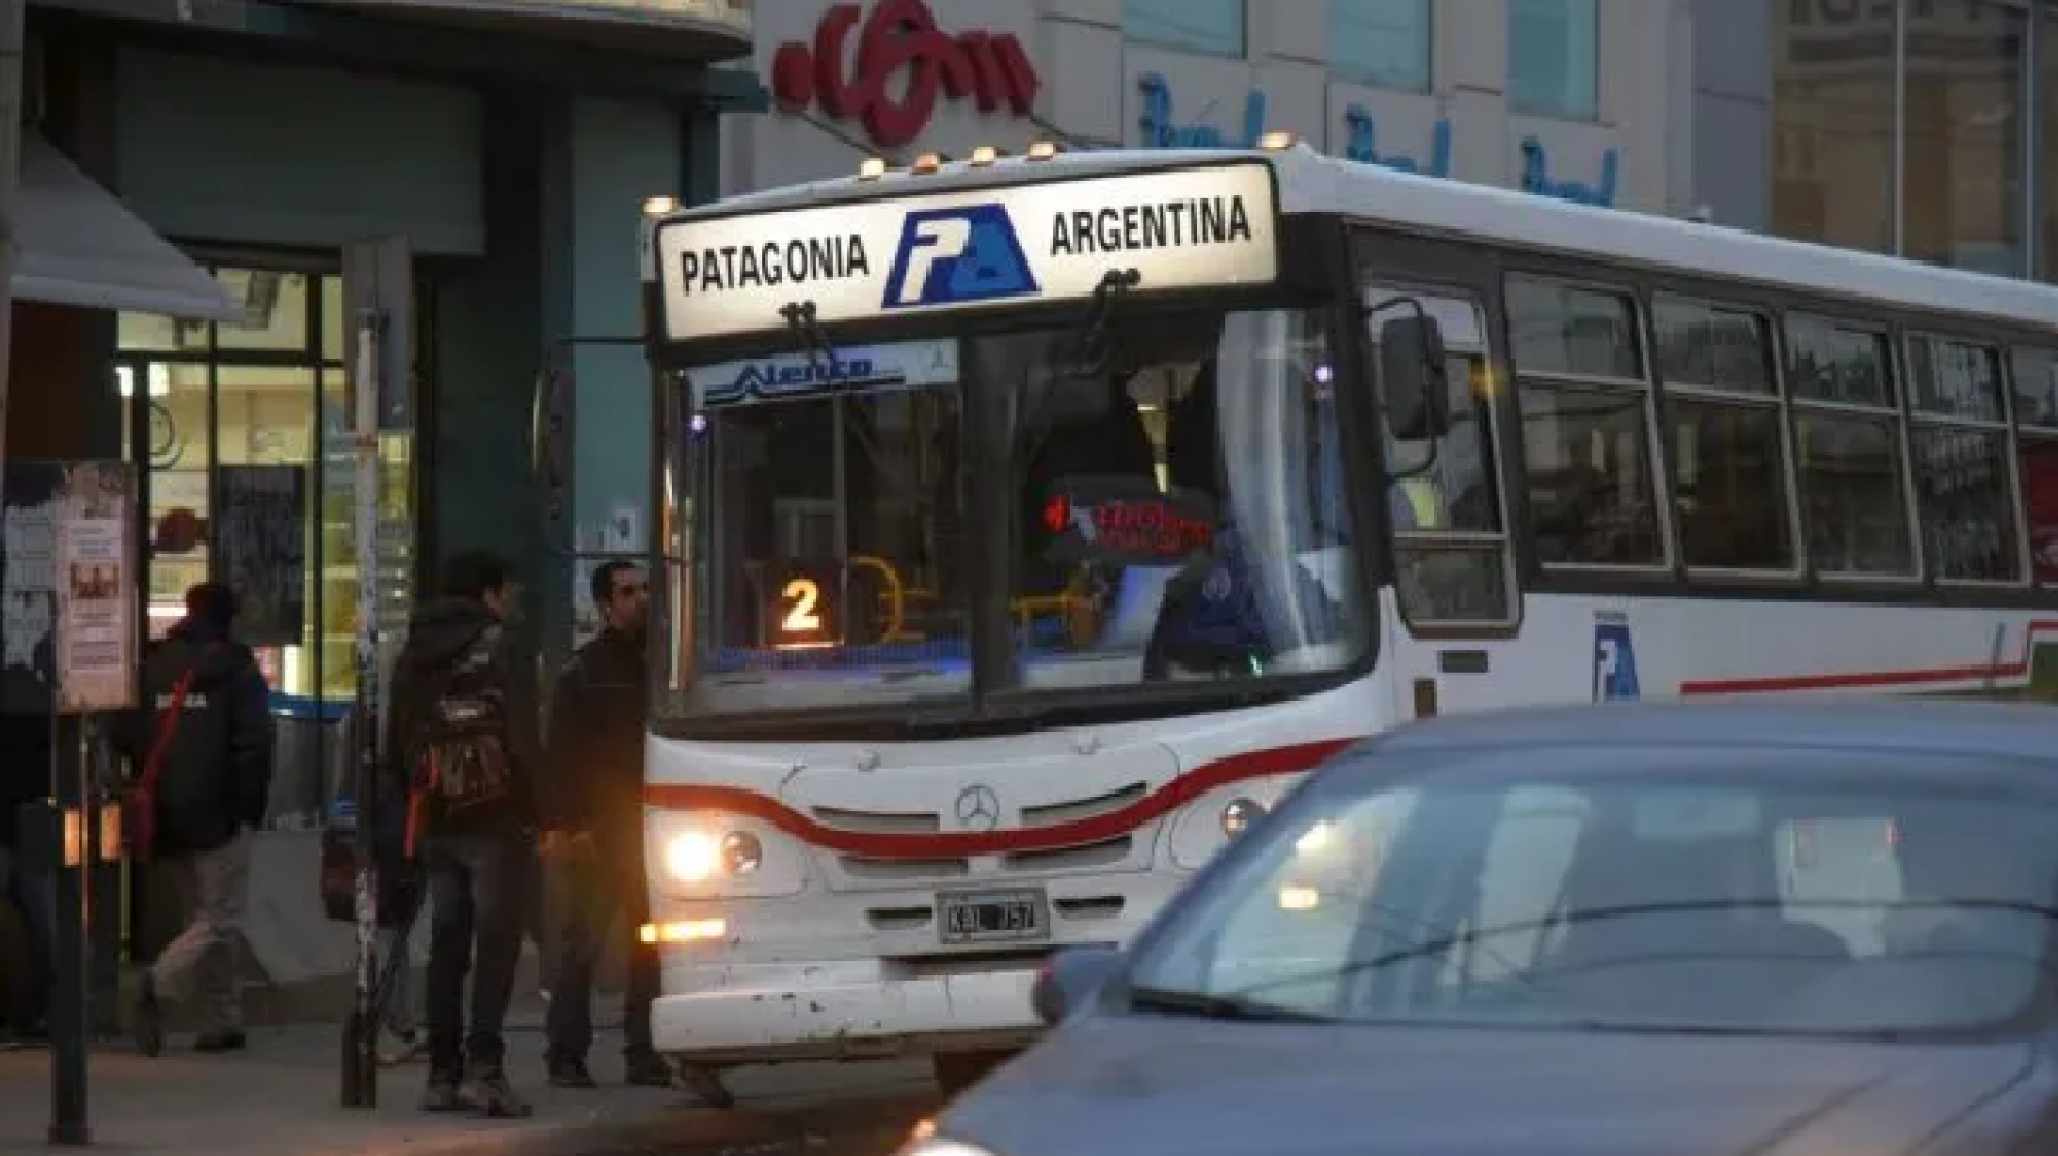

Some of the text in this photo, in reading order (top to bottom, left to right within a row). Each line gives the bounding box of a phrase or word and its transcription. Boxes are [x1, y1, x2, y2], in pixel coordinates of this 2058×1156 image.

[679, 233, 870, 298] PATAGONIA
[1050, 195, 1252, 256] ARGENTINA
[781, 579, 821, 630] 2
